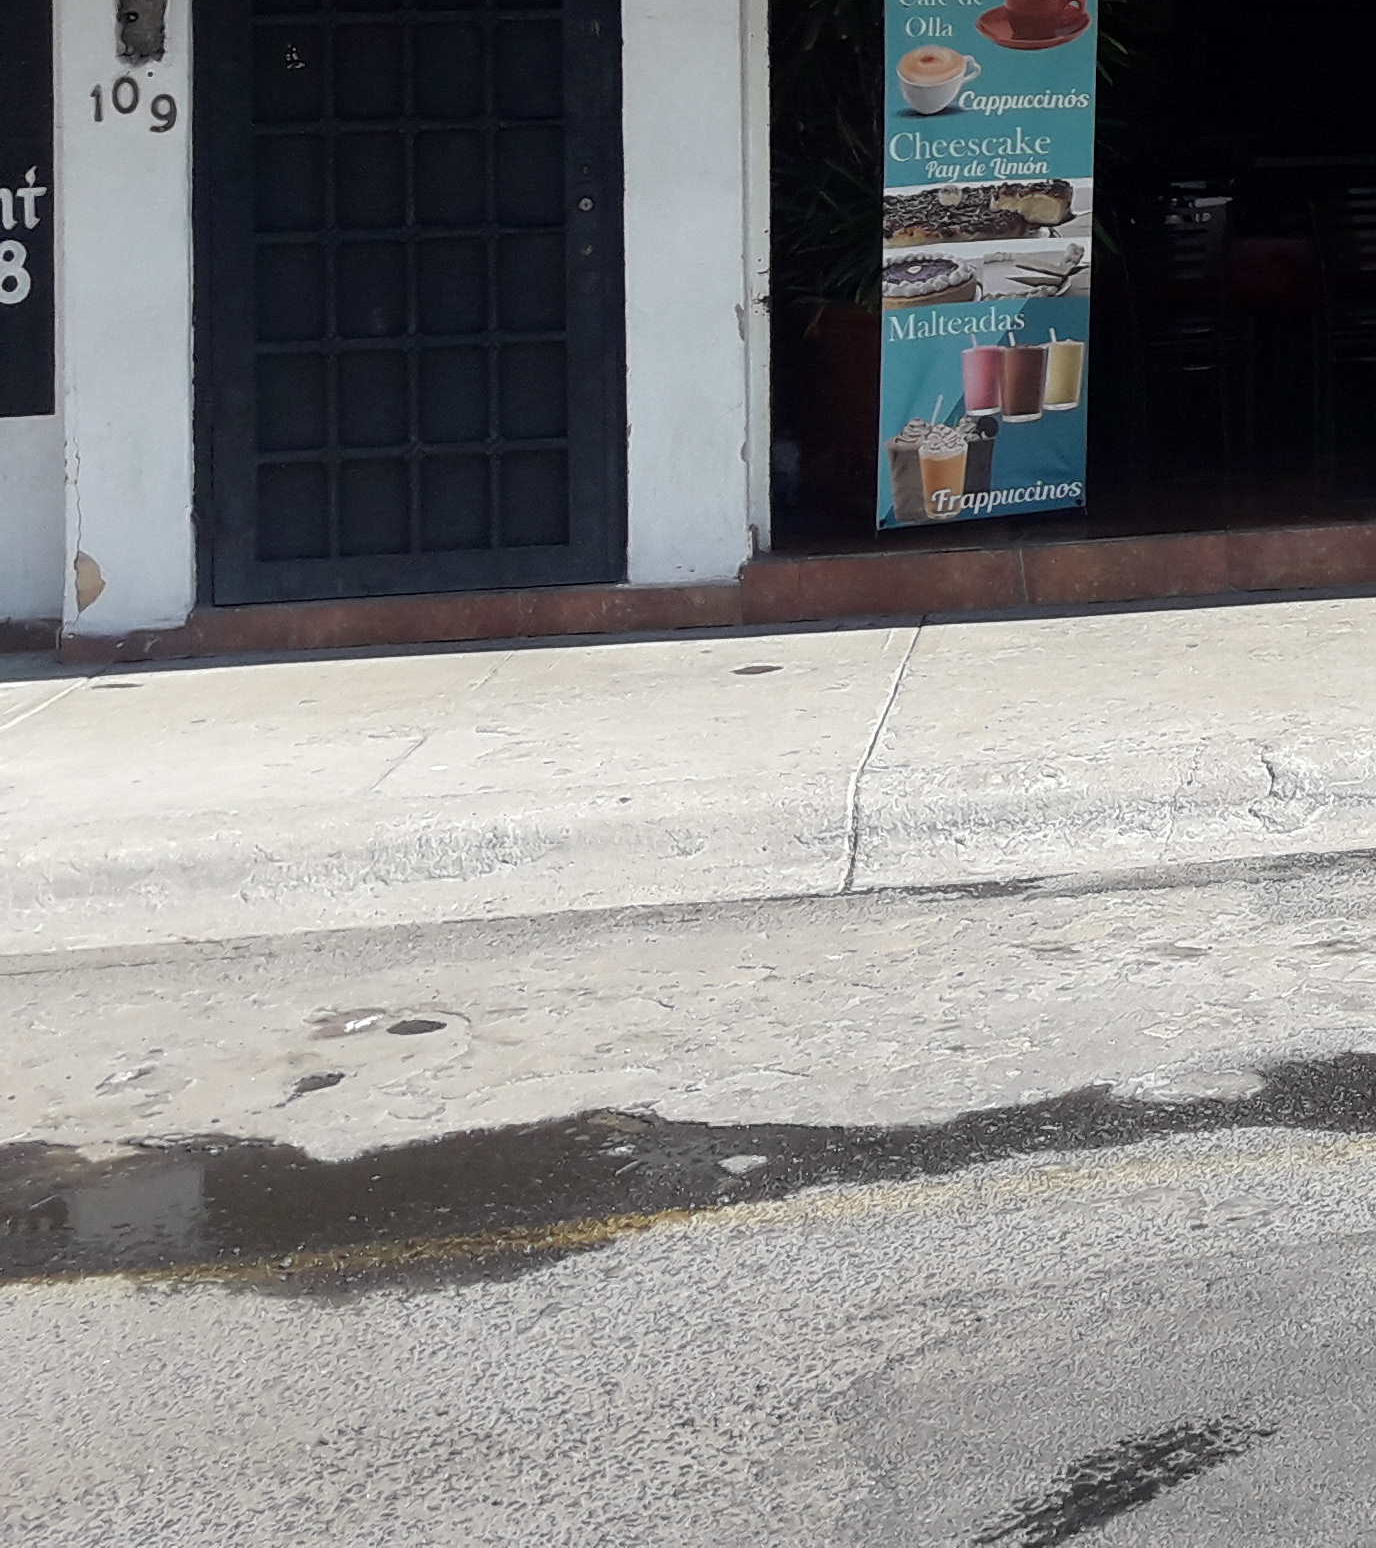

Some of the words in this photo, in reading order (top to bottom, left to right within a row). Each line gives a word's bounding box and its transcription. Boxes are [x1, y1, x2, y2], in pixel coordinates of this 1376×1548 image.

[904, 16, 953, 38] Olla
[89, 75, 178, 133] 109
[925, 160, 960, 182] Pay
[963, 159, 986, 178] de
[989, 156, 1049, 179] Limón
[889, 306, 1026, 343] Malteadas
[931, 479, 1083, 515] Frappuccinos
